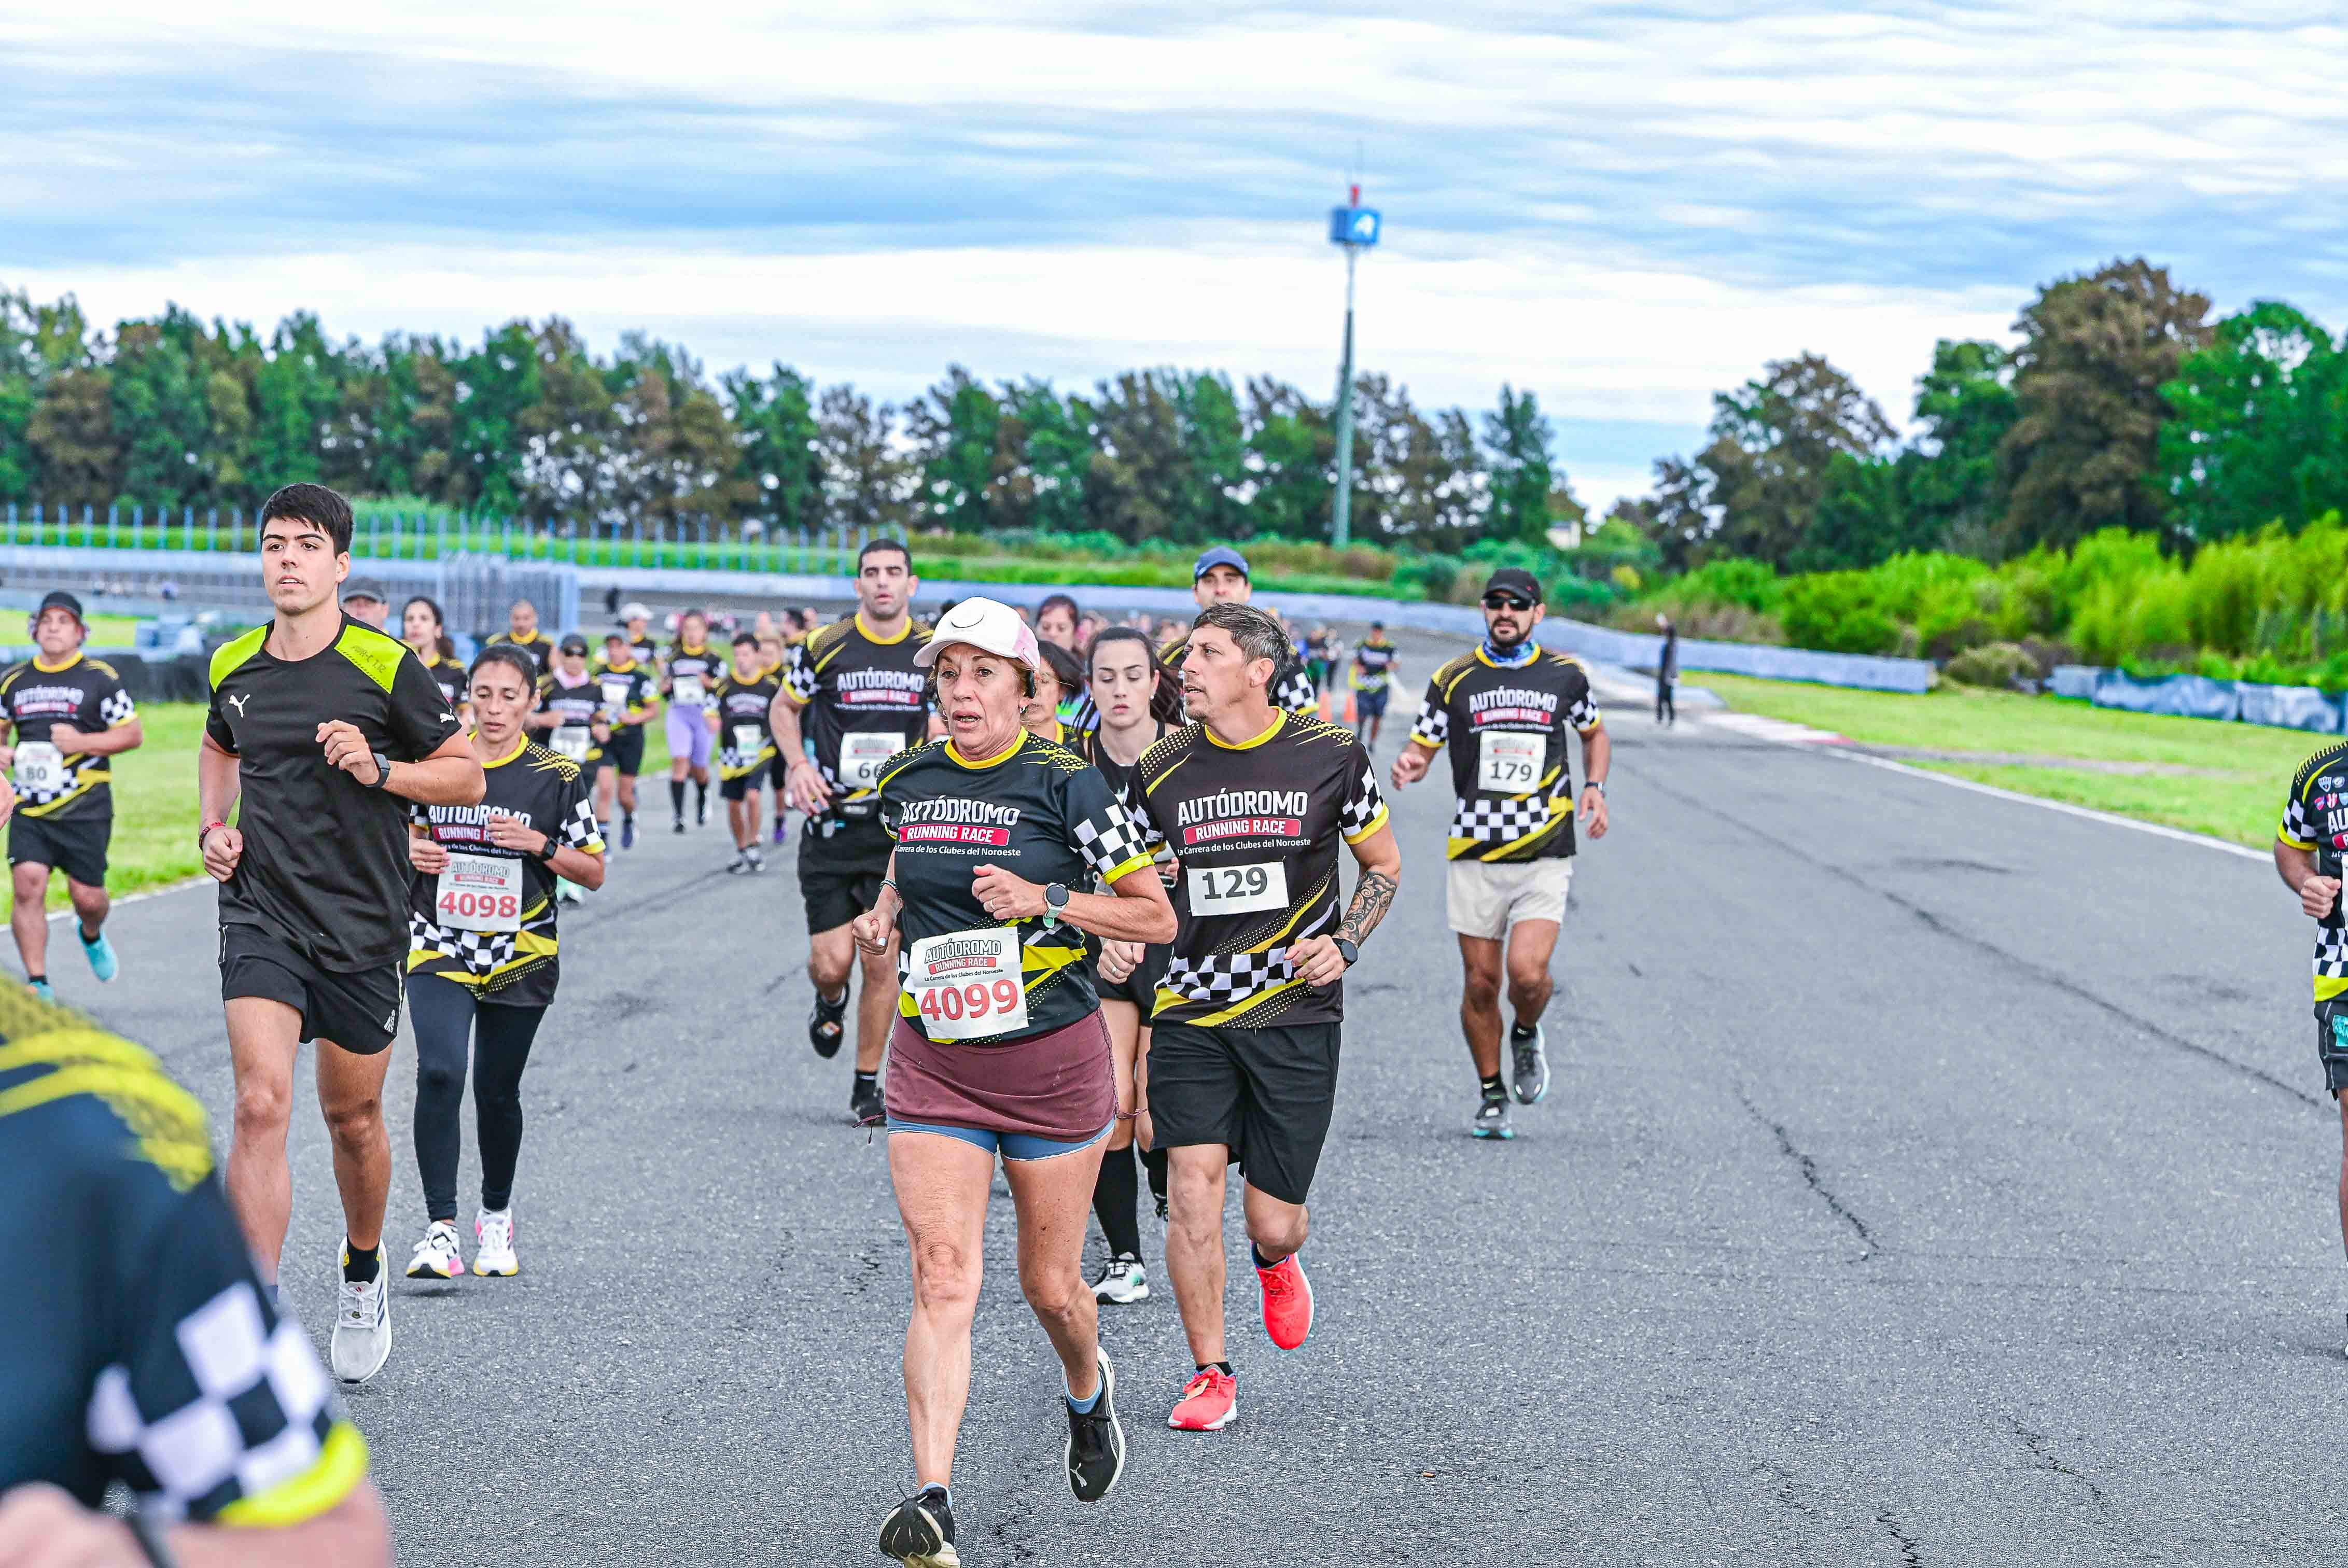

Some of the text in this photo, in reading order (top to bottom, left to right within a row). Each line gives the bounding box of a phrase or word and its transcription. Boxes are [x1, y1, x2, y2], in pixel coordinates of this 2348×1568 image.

[837, 666, 925, 692] AUTÓDROMO
[1469, 685, 1557, 713] AUTÓDROMO
[1490, 761, 1532, 781] 179
[899, 795, 1021, 825] AUTÓDROMO
[1178, 787, 1308, 827] AUTÓDROMO
[439, 827, 481, 840] RUNNING
[907, 826, 995, 843] RUNNING RACE
[1195, 820, 1286, 841] RUNNING RACE
[939, 846, 965, 855] Clubes
[1184, 846, 1209, 855] Carrera
[1235, 841, 1261, 850] Clubes
[1276, 838, 1311, 847] Noroeste
[1202, 867, 1267, 900] 129
[439, 891, 516, 918] 4098
[925, 939, 1001, 963] AUTÓDROMO
[935, 958, 988, 972] RUNNING RACE
[921, 979, 1017, 1020] 4099
